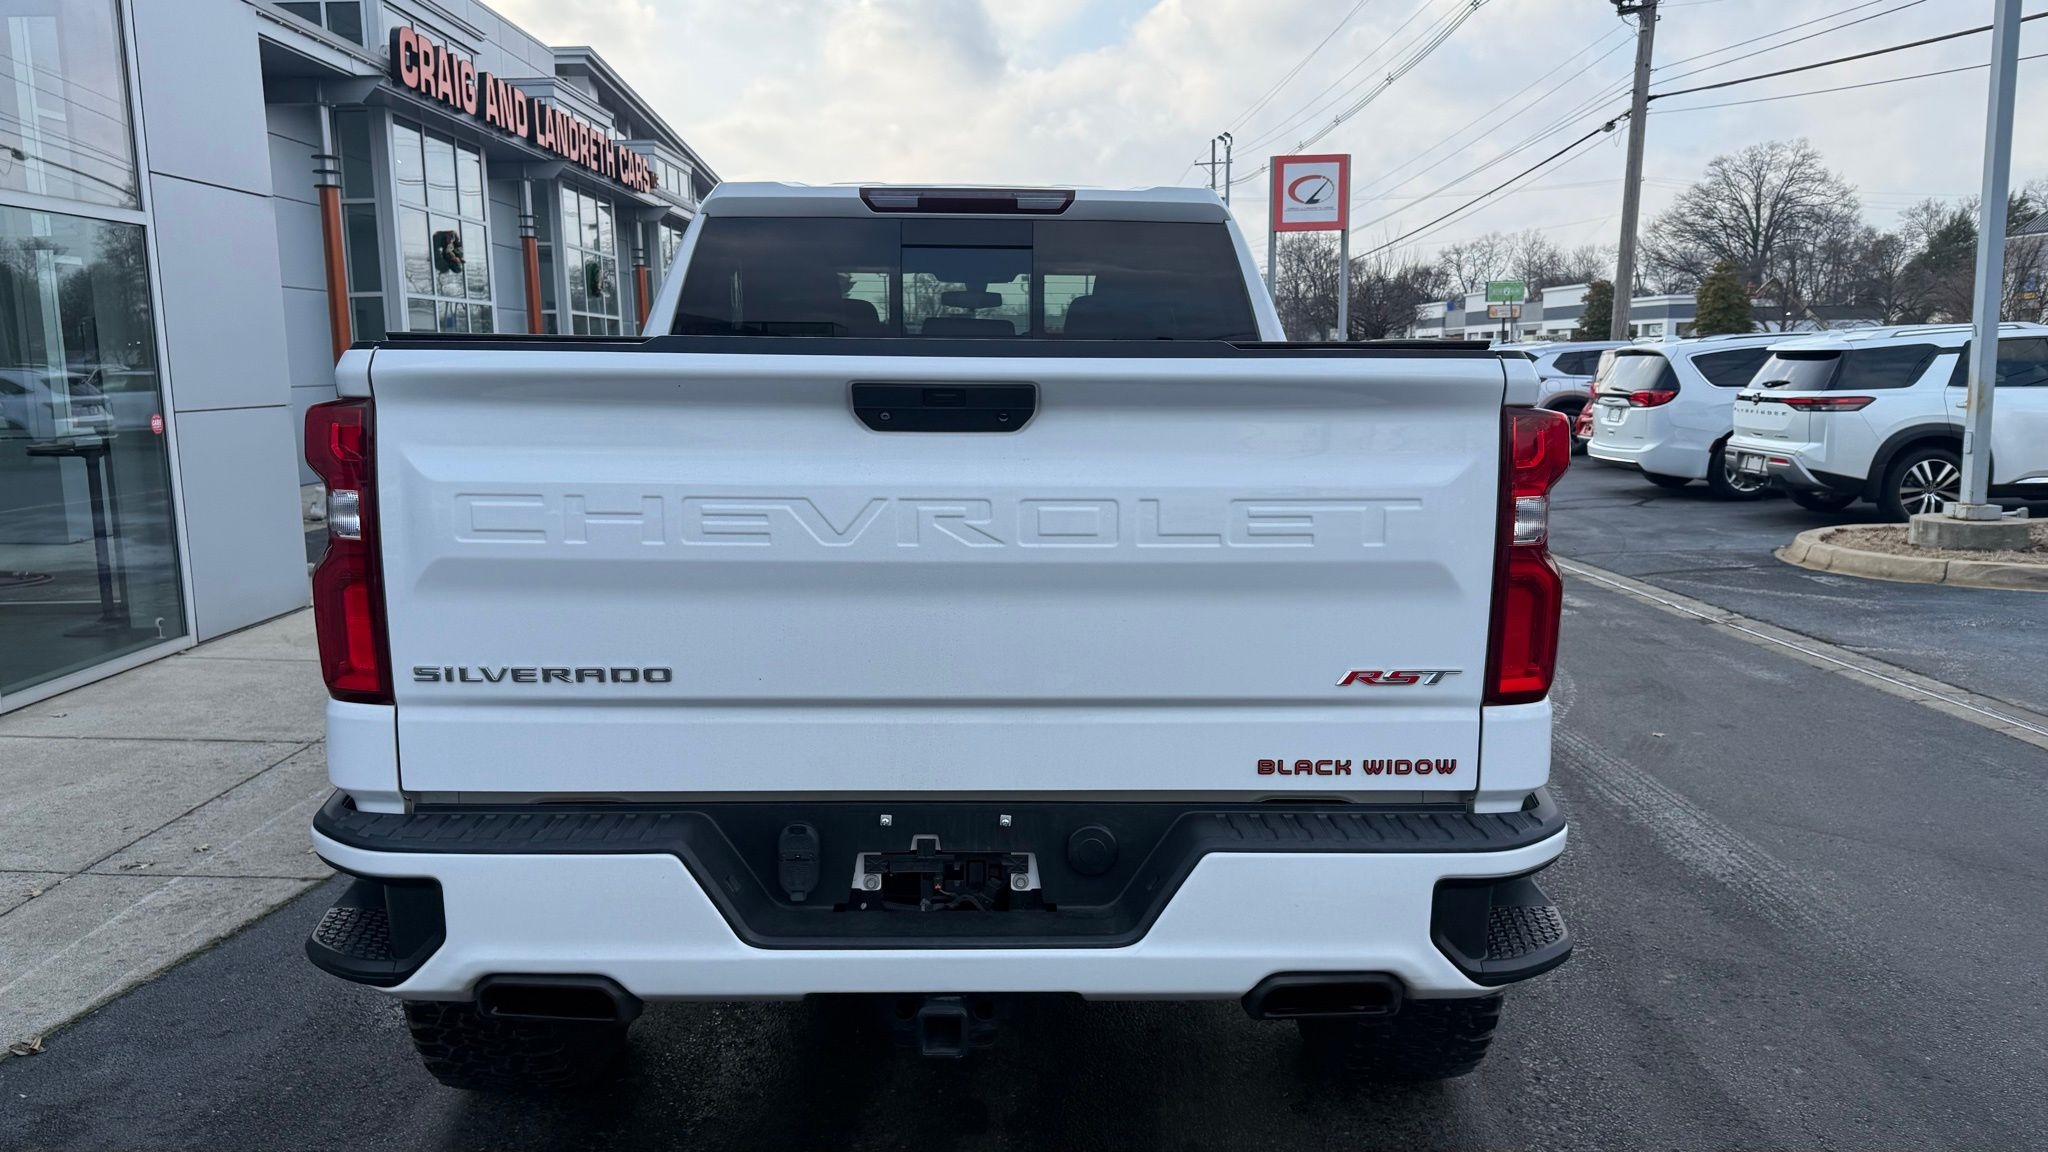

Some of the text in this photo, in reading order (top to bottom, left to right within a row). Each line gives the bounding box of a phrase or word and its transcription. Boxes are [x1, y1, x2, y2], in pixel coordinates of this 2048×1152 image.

[396, 25, 651, 194] CRAIG AND LANDRETH CARS
[455, 493, 1422, 547] CHEVROLET
[413, 665, 673, 683] SILVERADO
[1335, 669, 1463, 687] RST
[1257, 759, 1457, 776] BLACK WIDOW
